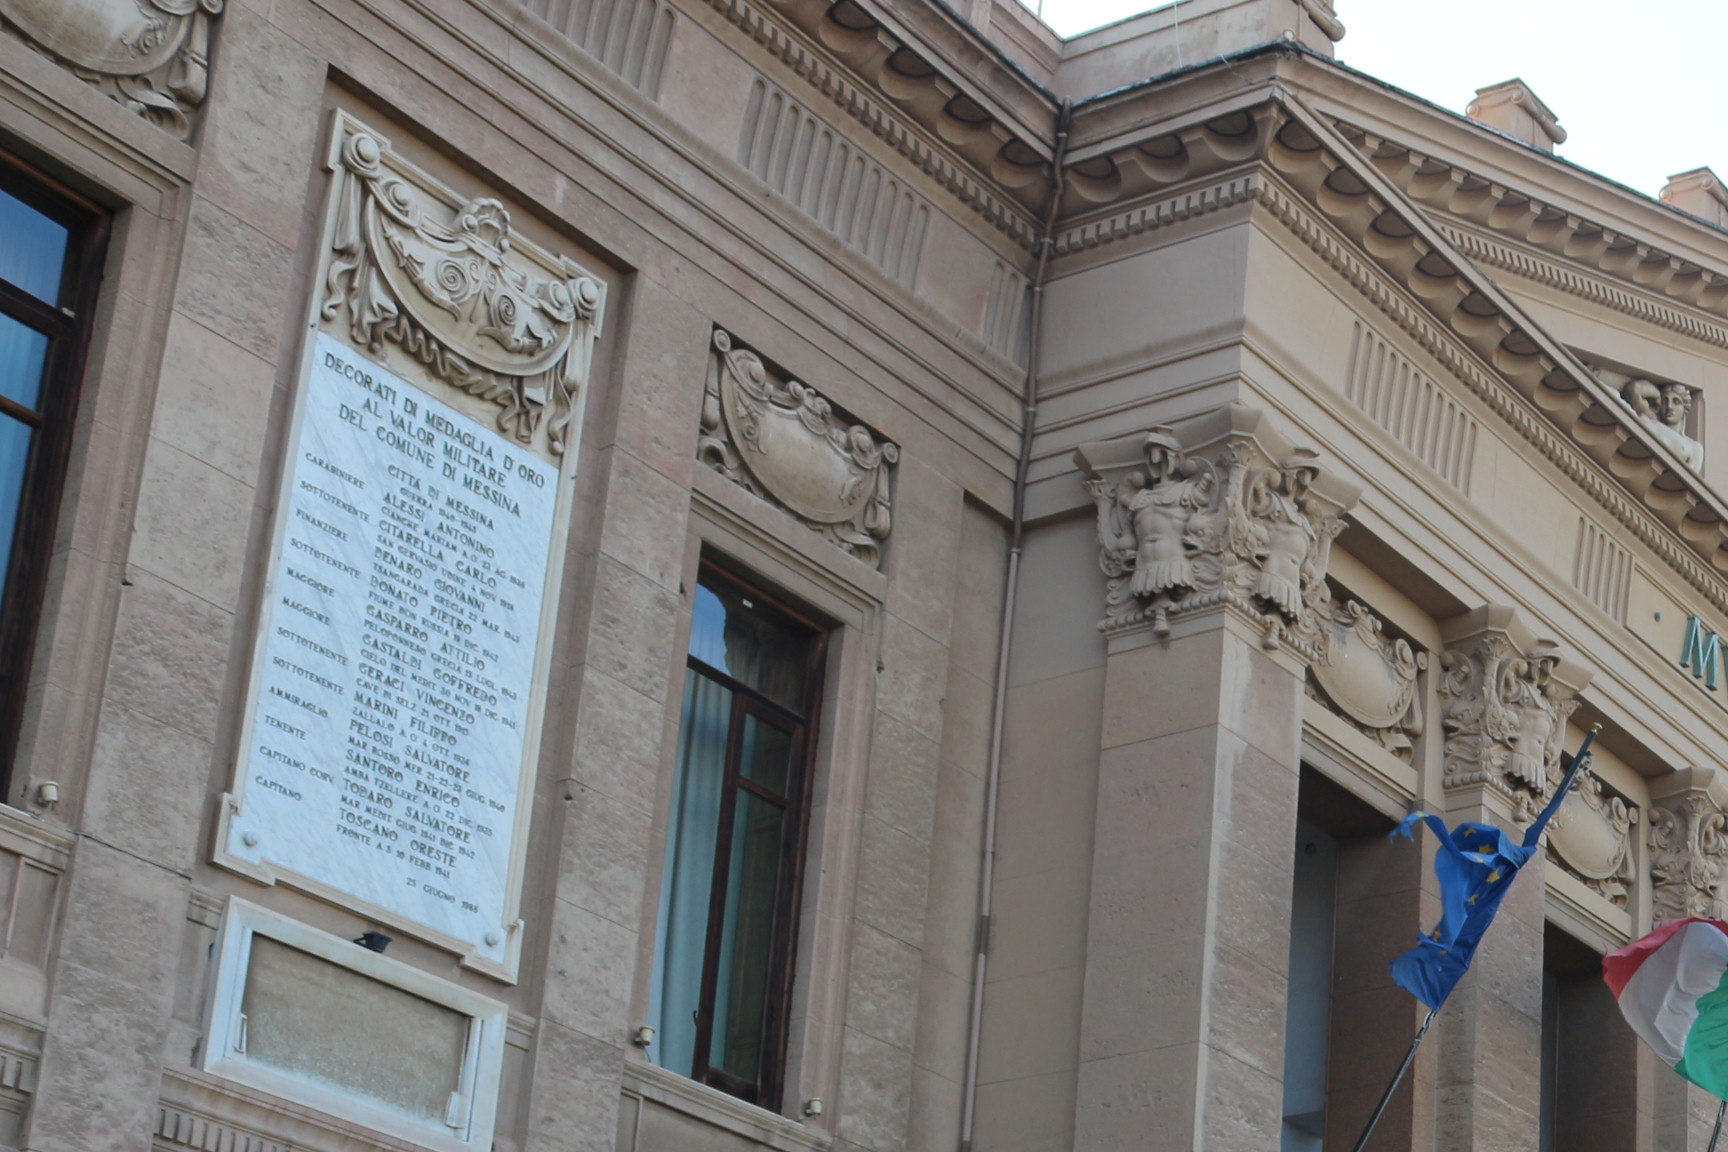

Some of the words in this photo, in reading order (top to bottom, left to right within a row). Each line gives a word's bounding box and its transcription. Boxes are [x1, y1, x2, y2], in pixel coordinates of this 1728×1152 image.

[324, 351, 396, 405] DECORATI
[403, 397, 417, 418] DI
[424, 409, 493, 461] MEDAGLIA
[361, 397, 382, 418] AL
[389, 409, 435, 448] VALOR
[442, 440, 506, 488] MILITARE
[305, 452, 364, 488] CARABINIERE
[382, 492, 424, 522] ALESSI
[436, 521, 494, 558] ANTONINO
[338, 403, 366, 431] DEL
[375, 425, 435, 469] COMUNE
[442, 461, 456, 481] DI
[462, 473, 520, 517] MESSINA
[399, 487, 432, 510] GUERRA
[300, 480, 368, 522] SOTTOTENENTE
[378, 519, 443, 561] CITARELLA
[455, 560, 496, 588] CARLO
[427, 485, 439, 499] DI
[445, 495, 493, 530] MESSINA
[290, 537, 360, 578] SOTTOTENENTE
[369, 574, 418, 607] DONATO
[429, 605, 472, 634] PIETRO
[296, 508, 347, 541] FINANZIERE
[433, 578, 484, 612] GIOVANNI
[377, 534, 393, 548] SAN
[397, 545, 437, 571] GERVASIO
[441, 567, 466, 586] UDINE
[433, 594, 463, 615] GRECIA
[282, 596, 329, 625] MAGGIORE
[362, 633, 421, 670] GASTALDI
[432, 667, 497, 705] GOFFREDO
[286, 567, 334, 596] MAGGIORE
[366, 604, 428, 642] GASPARRO
[439, 641, 485, 670] ATTILIO
[368, 590, 393, 609] FIUME
[421, 616, 448, 637] RUSSIA
[272, 656, 343, 694] SOTTOTENENTE
[354, 690, 397, 719] MARINI
[409, 715, 456, 746] FILIPPO
[277, 626, 347, 665] SOTTOTENENTE
[358, 662, 404, 692] GERACI
[416, 688, 474, 724] VINCENZO
[356, 677, 378, 694] CAVE
[395, 695, 416, 711] SELZ
[360, 648, 386, 666] CIELO
[390, 662, 405, 676] DEL
[430, 652, 461, 673] GRECIA
[265, 714, 305, 739] TENENTE
[345, 748, 403, 782] SANTORO
[415, 779, 460, 807] ENRICO
[269, 685, 328, 718] AMMIRAGLIO
[349, 718, 393, 748] PELOSI
[404, 744, 470, 783] SALVATORE
[371, 745, 400, 764] ROSSO
[255, 775, 301, 800] CAPITANO
[339, 807, 398, 841] TOSCANO
[409, 839, 456, 867] ORESTE
[259, 745, 305, 770] CAPITANO
[404, 806, 470, 843] SALVATORE
[336, 823, 370, 845] FRONTE
[423, 884, 455, 902] GIUGNO
